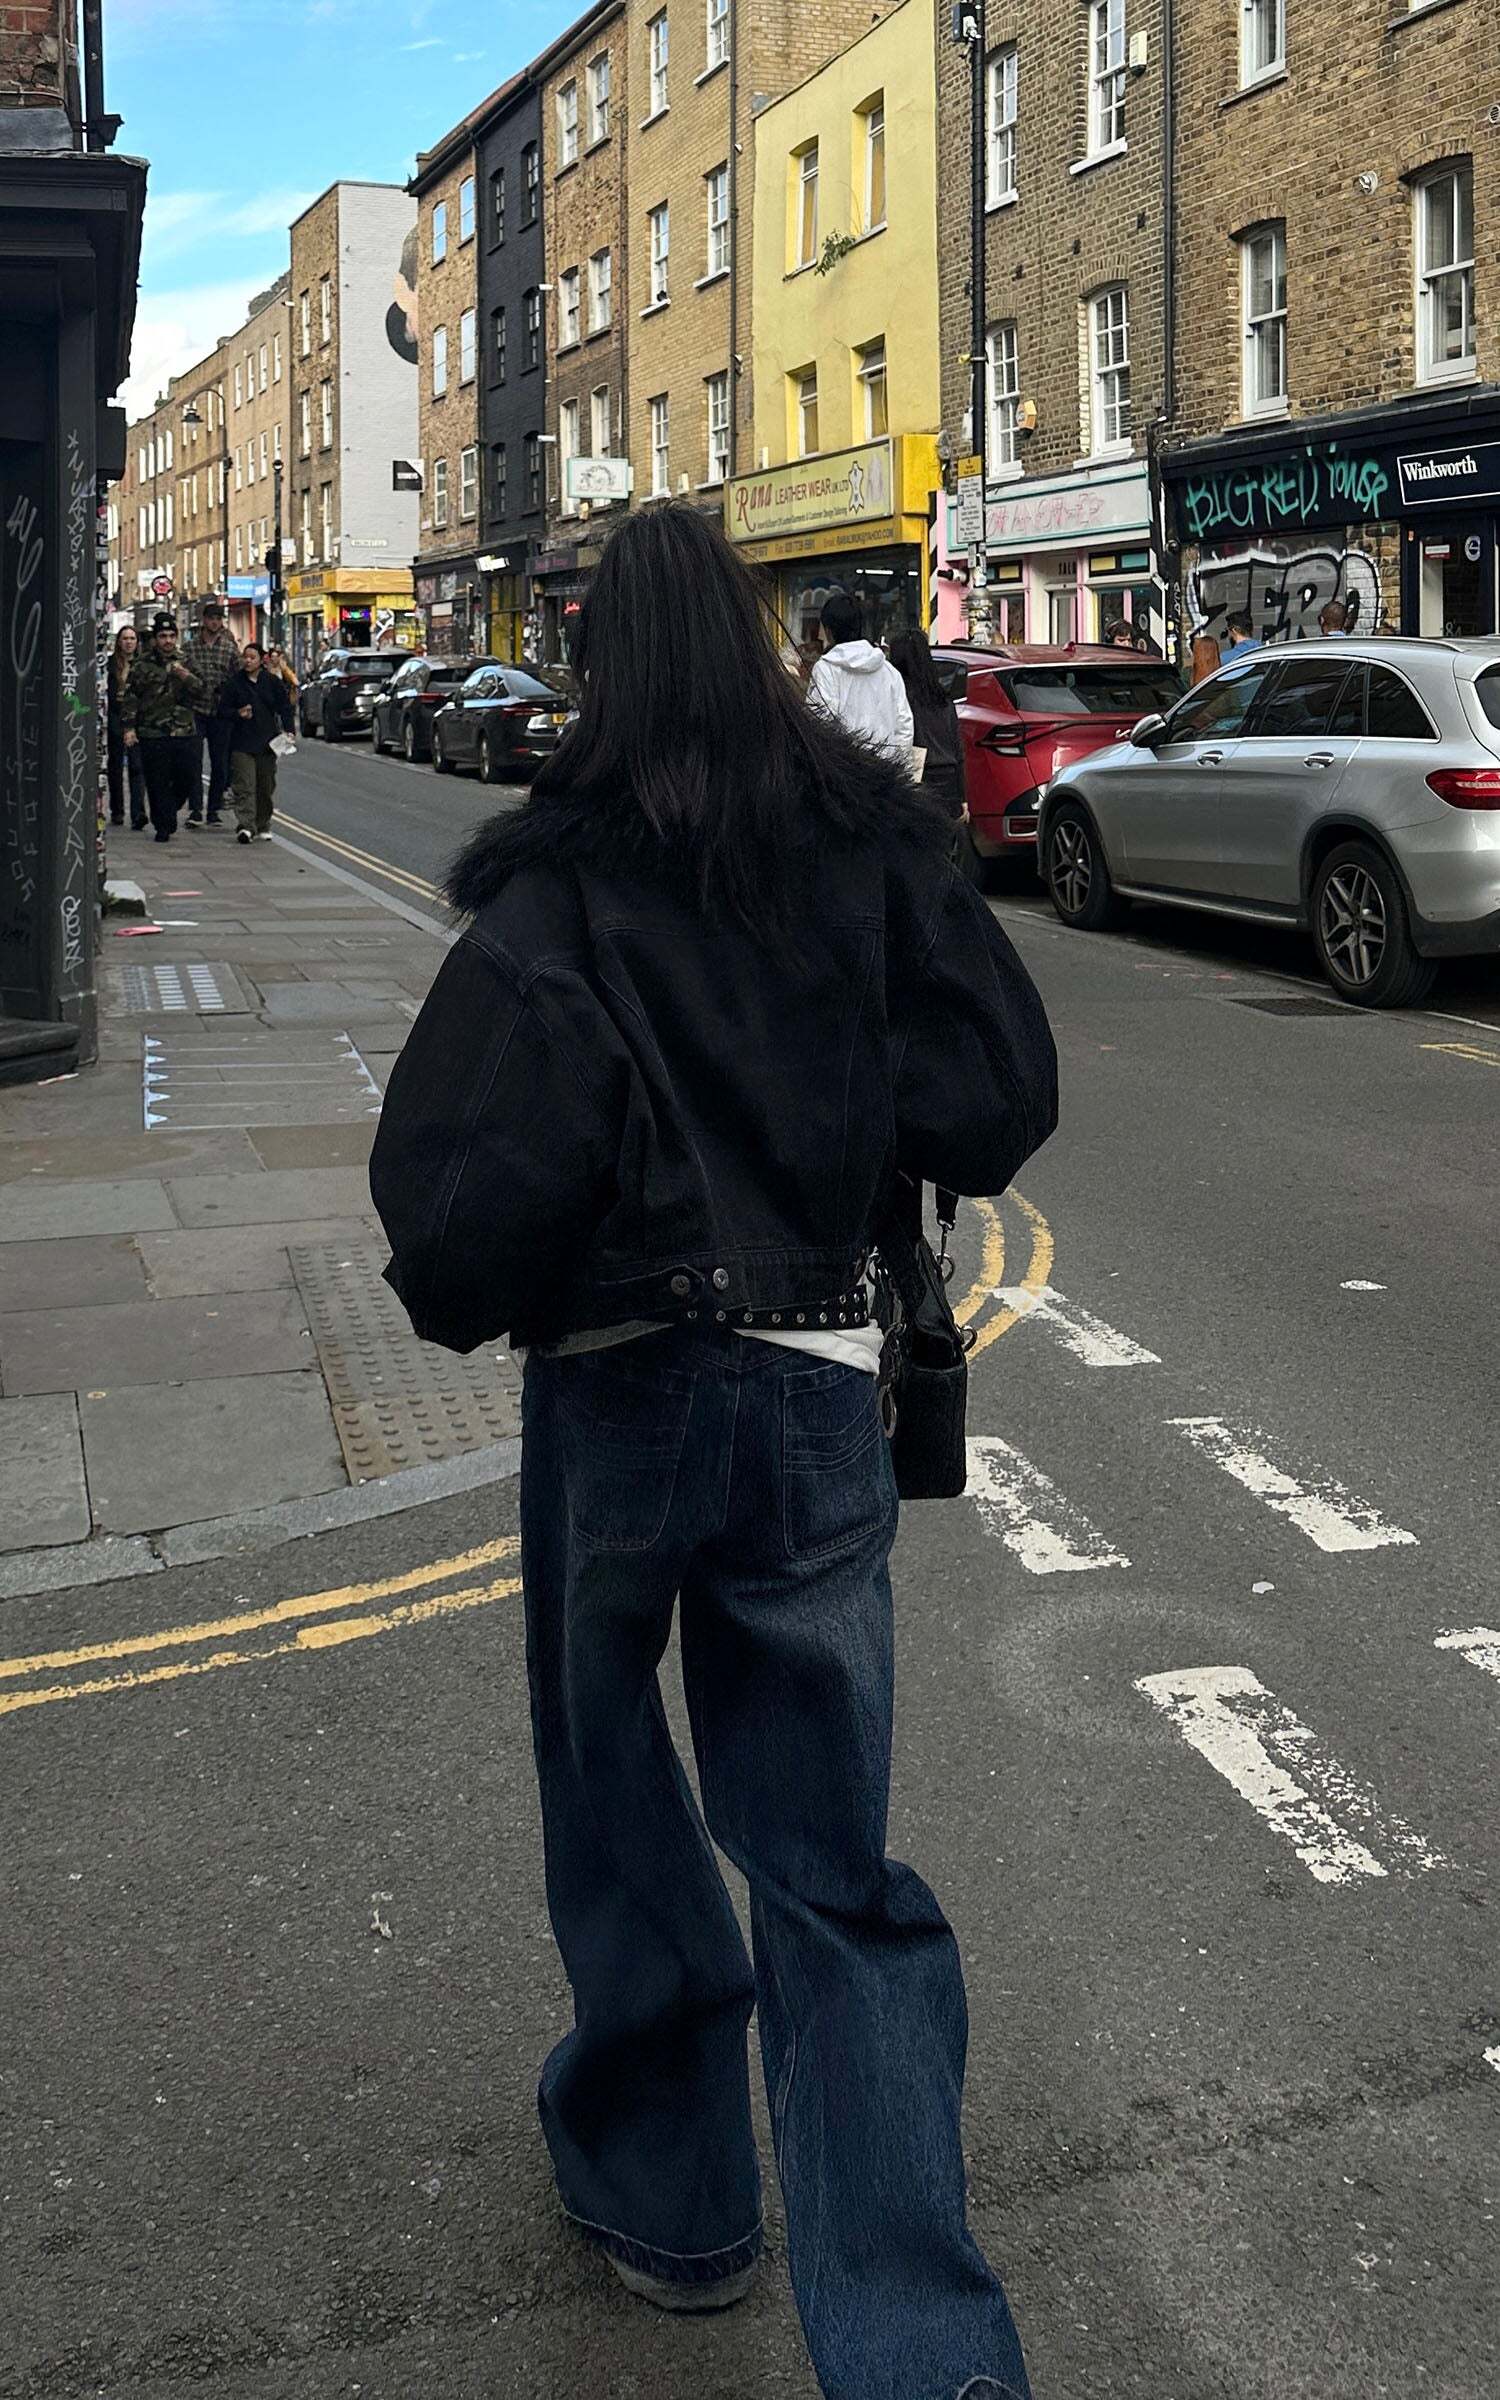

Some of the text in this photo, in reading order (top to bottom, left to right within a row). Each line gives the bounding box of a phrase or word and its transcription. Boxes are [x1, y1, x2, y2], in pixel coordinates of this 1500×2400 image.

[1403, 454, 1478, 482] Winkworth
[775, 484, 808, 506] LEATHER
[808, 478, 832, 498] WEAR
